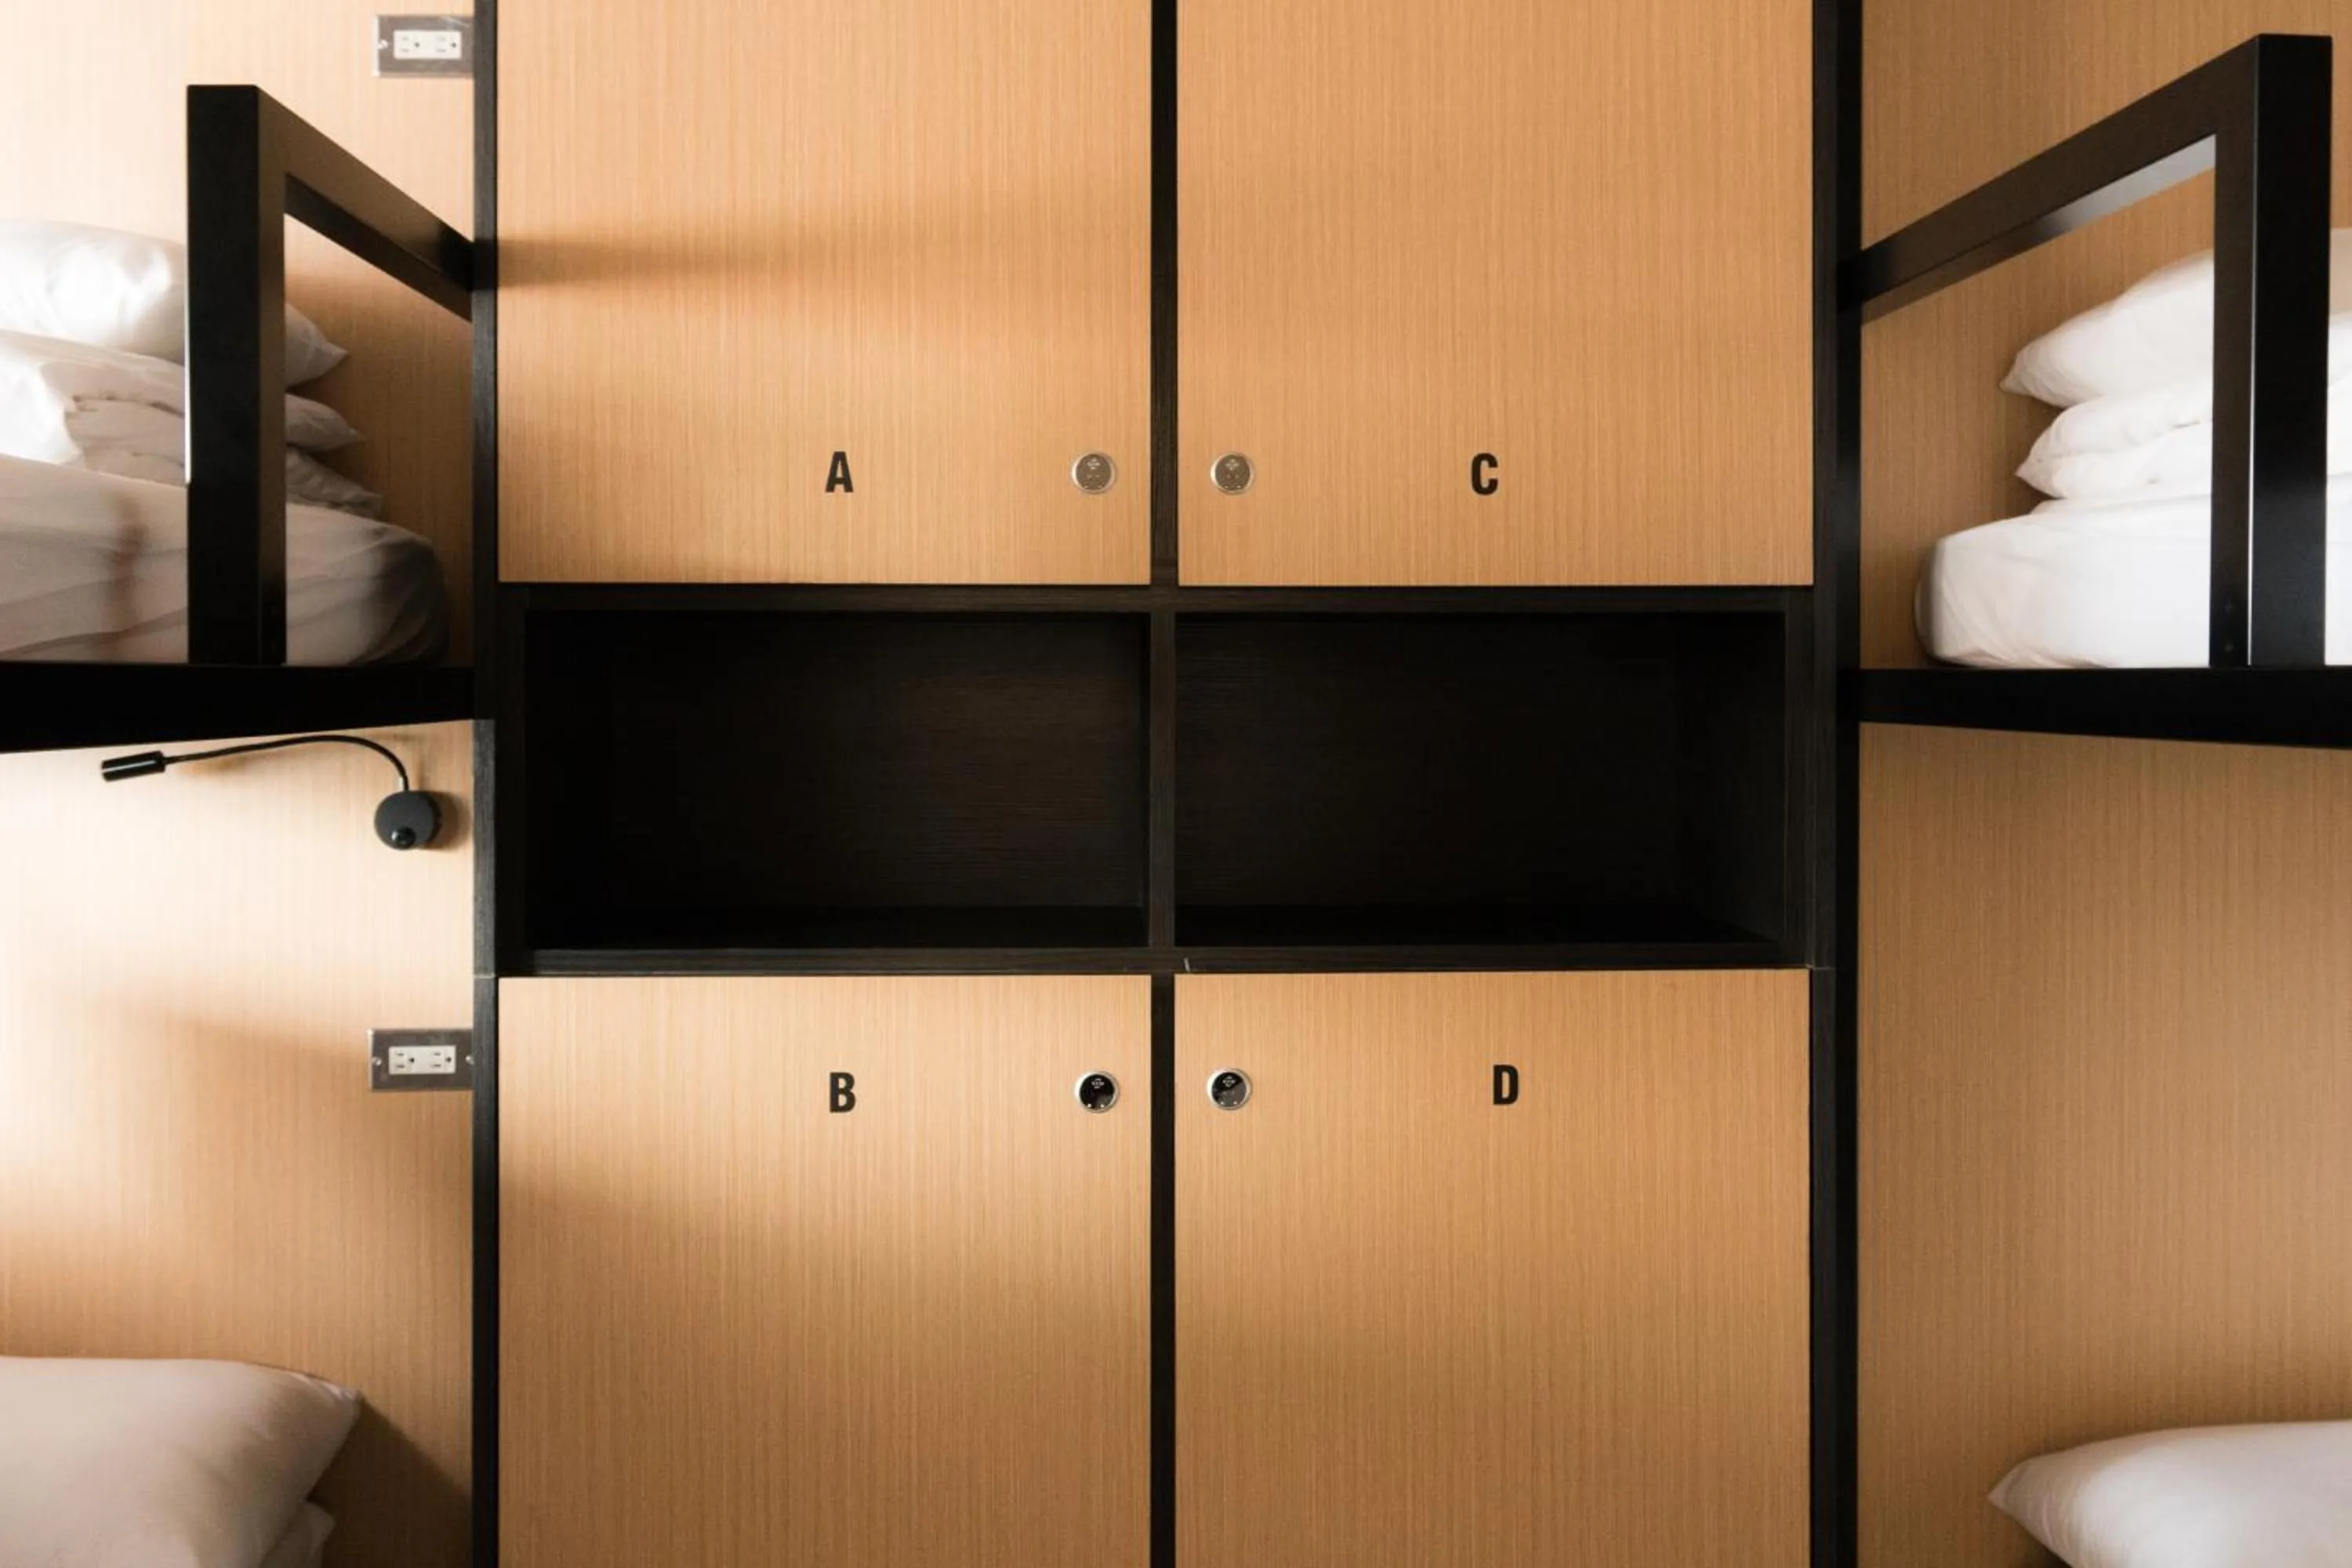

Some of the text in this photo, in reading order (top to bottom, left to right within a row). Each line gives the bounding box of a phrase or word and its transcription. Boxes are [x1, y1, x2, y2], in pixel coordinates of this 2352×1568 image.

[826, 451, 854, 493] A
[1471, 452, 1498, 496] C
[829, 1072, 855, 1112] B
[1493, 1064, 1519, 1105] D
